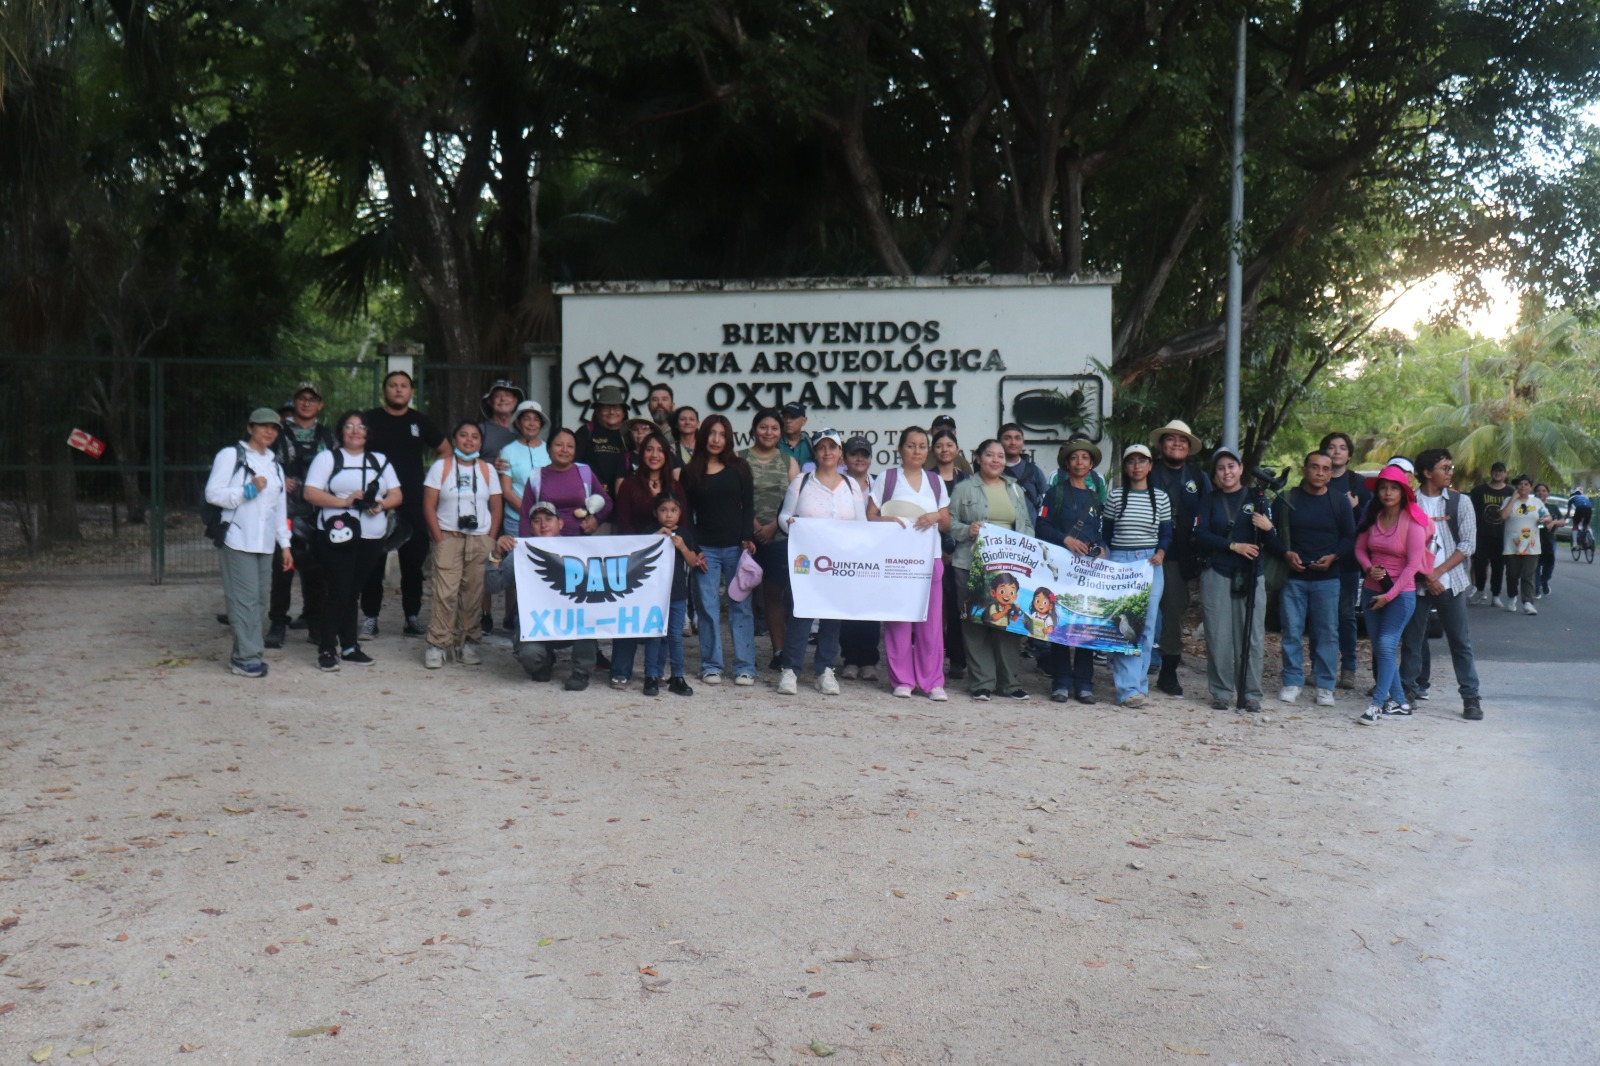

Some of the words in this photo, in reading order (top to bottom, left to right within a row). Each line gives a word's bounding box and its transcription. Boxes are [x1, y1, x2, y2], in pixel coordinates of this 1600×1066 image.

[722, 320, 940, 344] BIENVENIDOS
[657, 352, 742, 377] ZONA
[750, 343, 1007, 377] ARQUEOLÓGICA
[706, 379, 957, 411] OXTANKAH
[983, 535, 1003, 547] Tras
[1004, 534, 1017, 546] las
[1018, 536, 1038, 553] Alas
[814, 555, 880, 573] QUINTANA
[981, 547, 1040, 570] Biodiversidad
[562, 555, 629, 594] PAU
[832, 569, 856, 578] ROO
[1077, 575, 1149, 592] Biodiversidad!
[529, 606, 665, 638] XUL-HA
